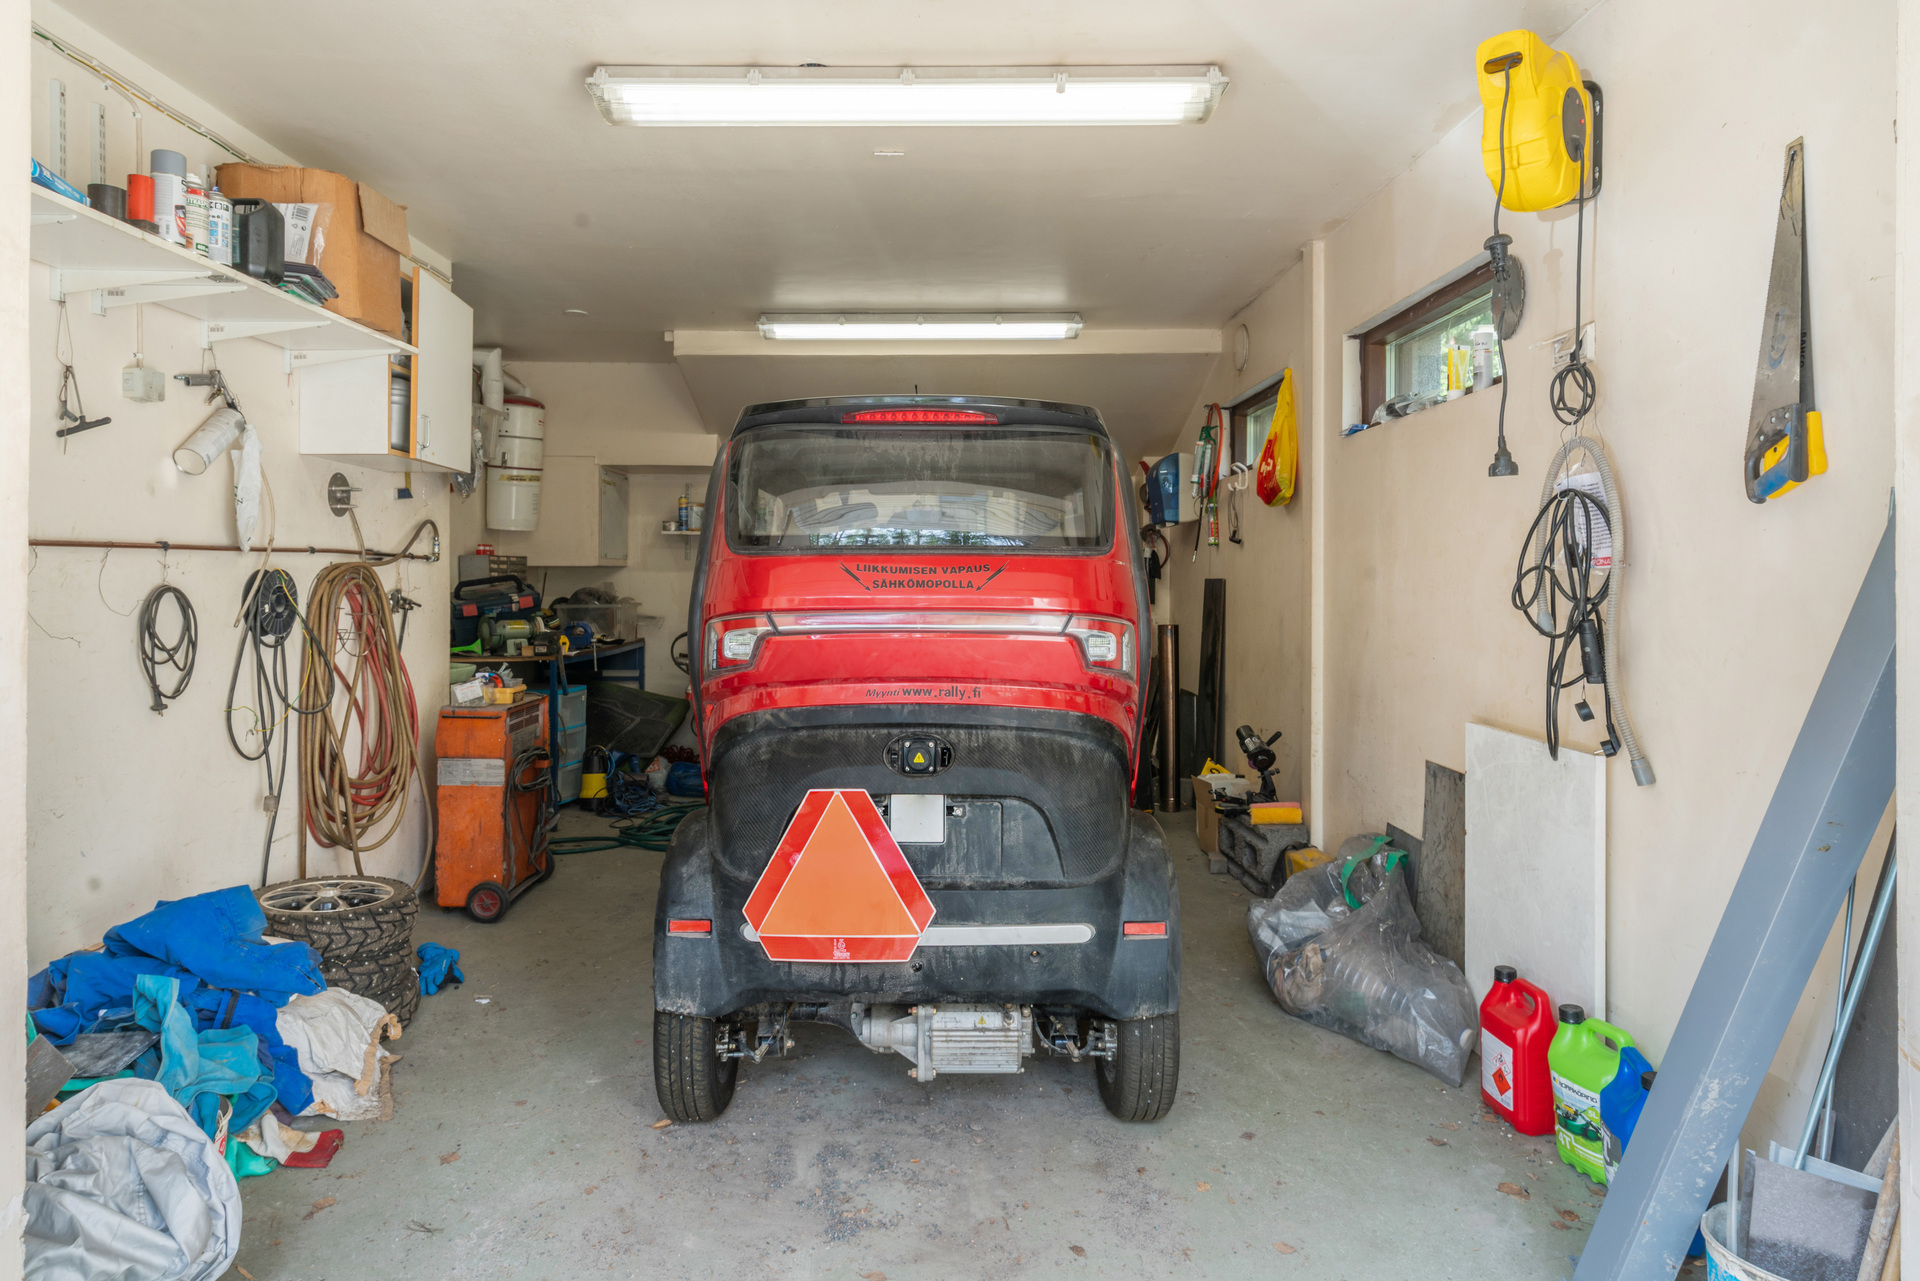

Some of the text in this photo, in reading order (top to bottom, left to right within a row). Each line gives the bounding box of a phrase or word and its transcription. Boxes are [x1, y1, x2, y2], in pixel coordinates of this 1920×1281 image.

[856, 563, 991, 575] LIIKKUMISEN VAPAUS
[872, 578, 974, 589] SÄHKÖMOPOLLA
[865, 688, 901, 699] Myynti
[1587, 1109, 1599, 1119] 5L
[1558, 1130, 1571, 1150] 4T
